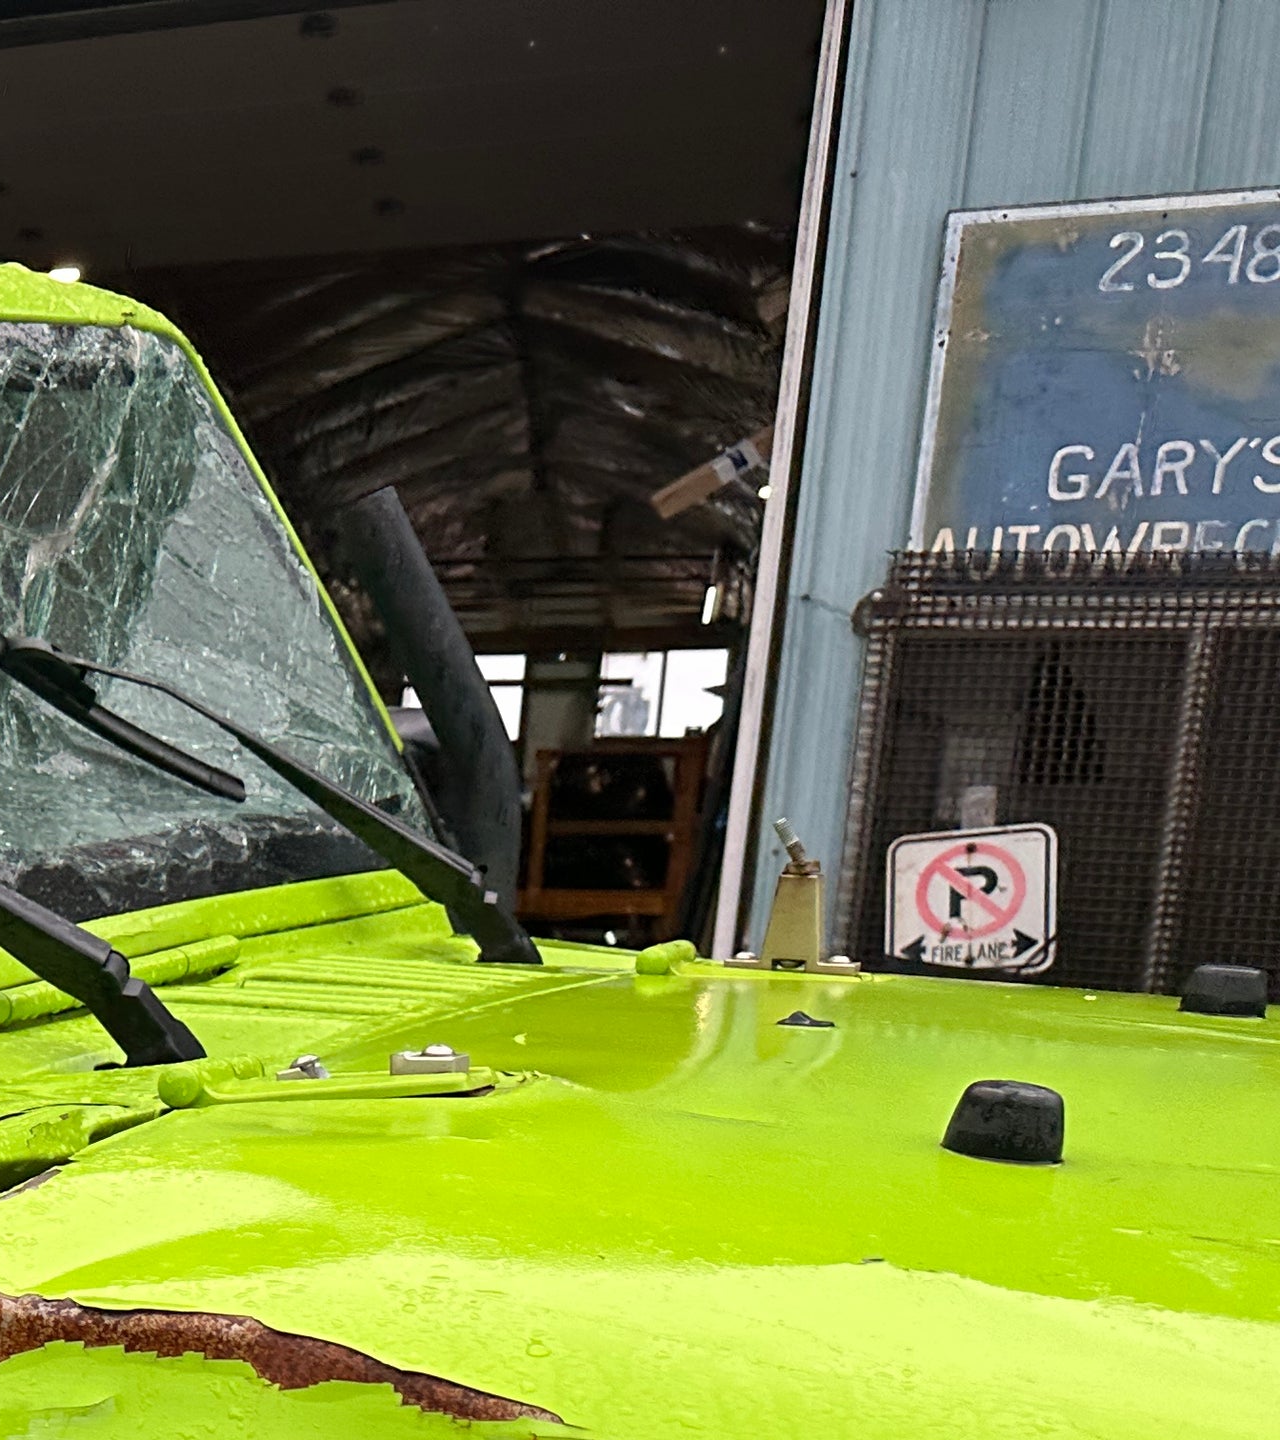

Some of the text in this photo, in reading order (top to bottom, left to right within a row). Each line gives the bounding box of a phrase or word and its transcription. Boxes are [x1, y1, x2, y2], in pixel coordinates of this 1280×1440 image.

[1047, 436, 1280, 501] GARY'S
[930, 941, 1011, 963] FIRE LANE
